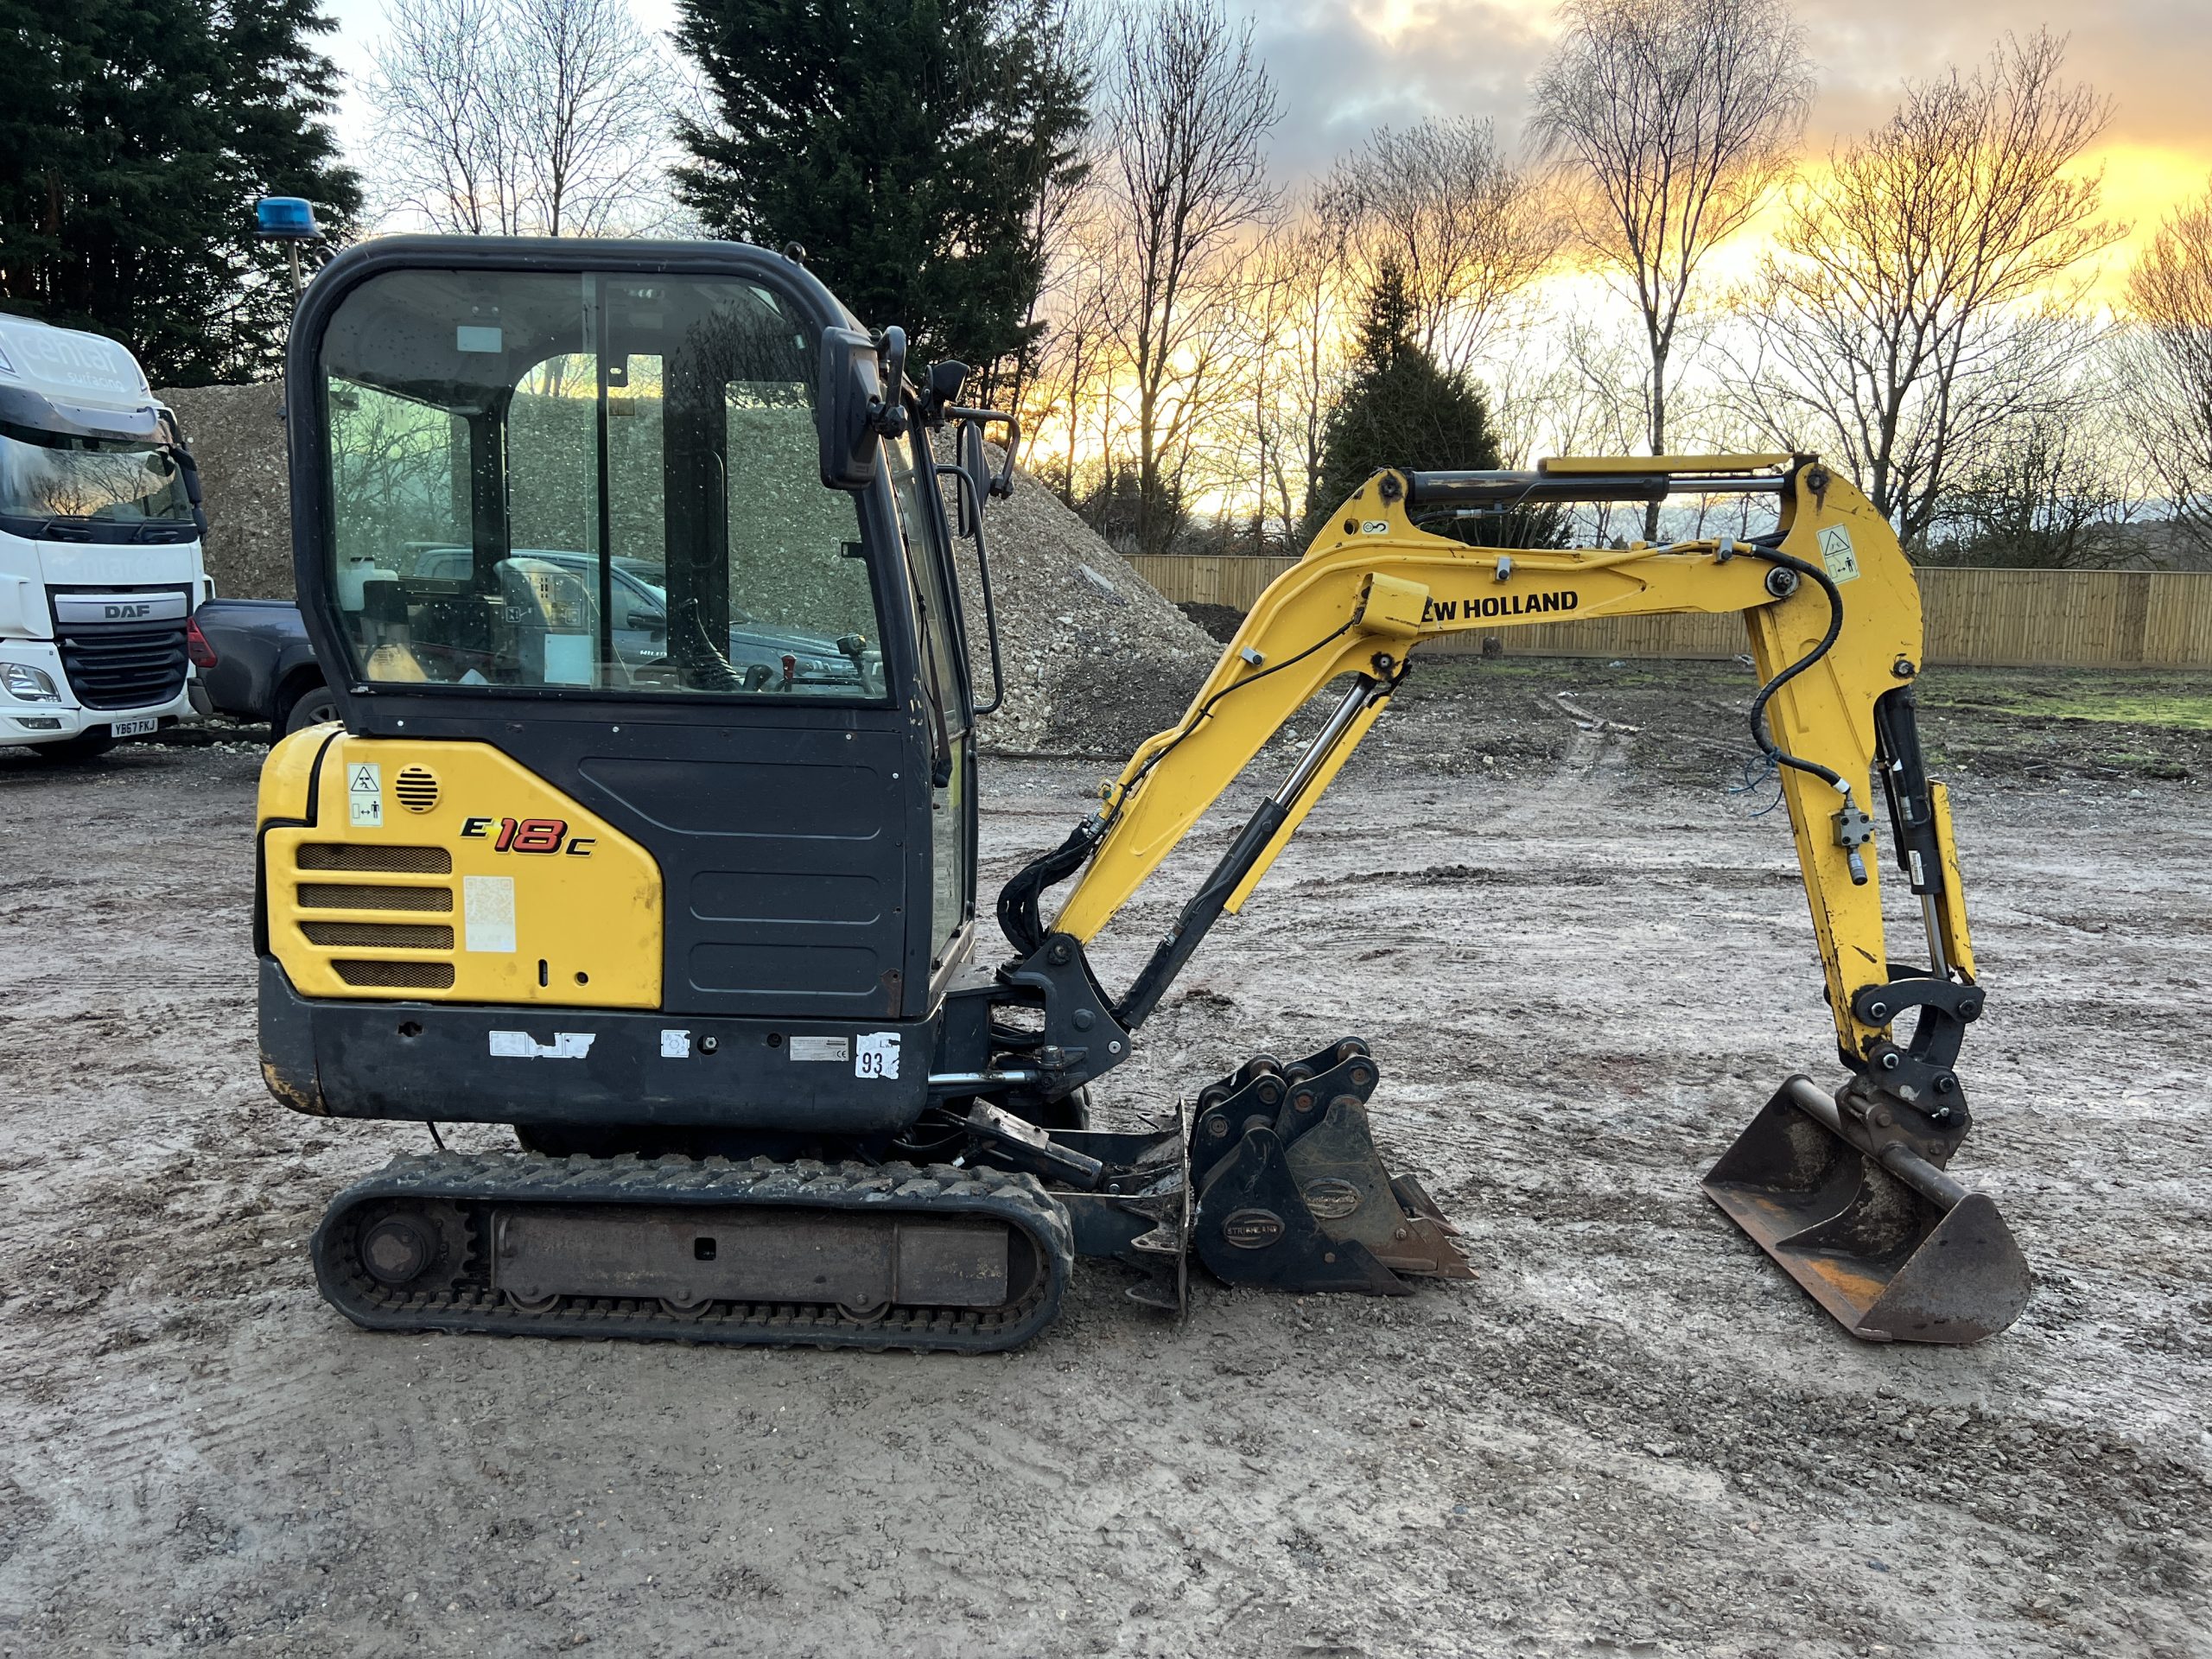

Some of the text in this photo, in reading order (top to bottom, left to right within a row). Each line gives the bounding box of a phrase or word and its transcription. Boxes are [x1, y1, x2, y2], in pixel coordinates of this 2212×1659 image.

[105, 605, 150, 619] DAF
[1463, 591, 1579, 619] HOLLAND
[116, 720, 156, 735] YB67 FKJ
[861, 1052, 882, 1074] 93
